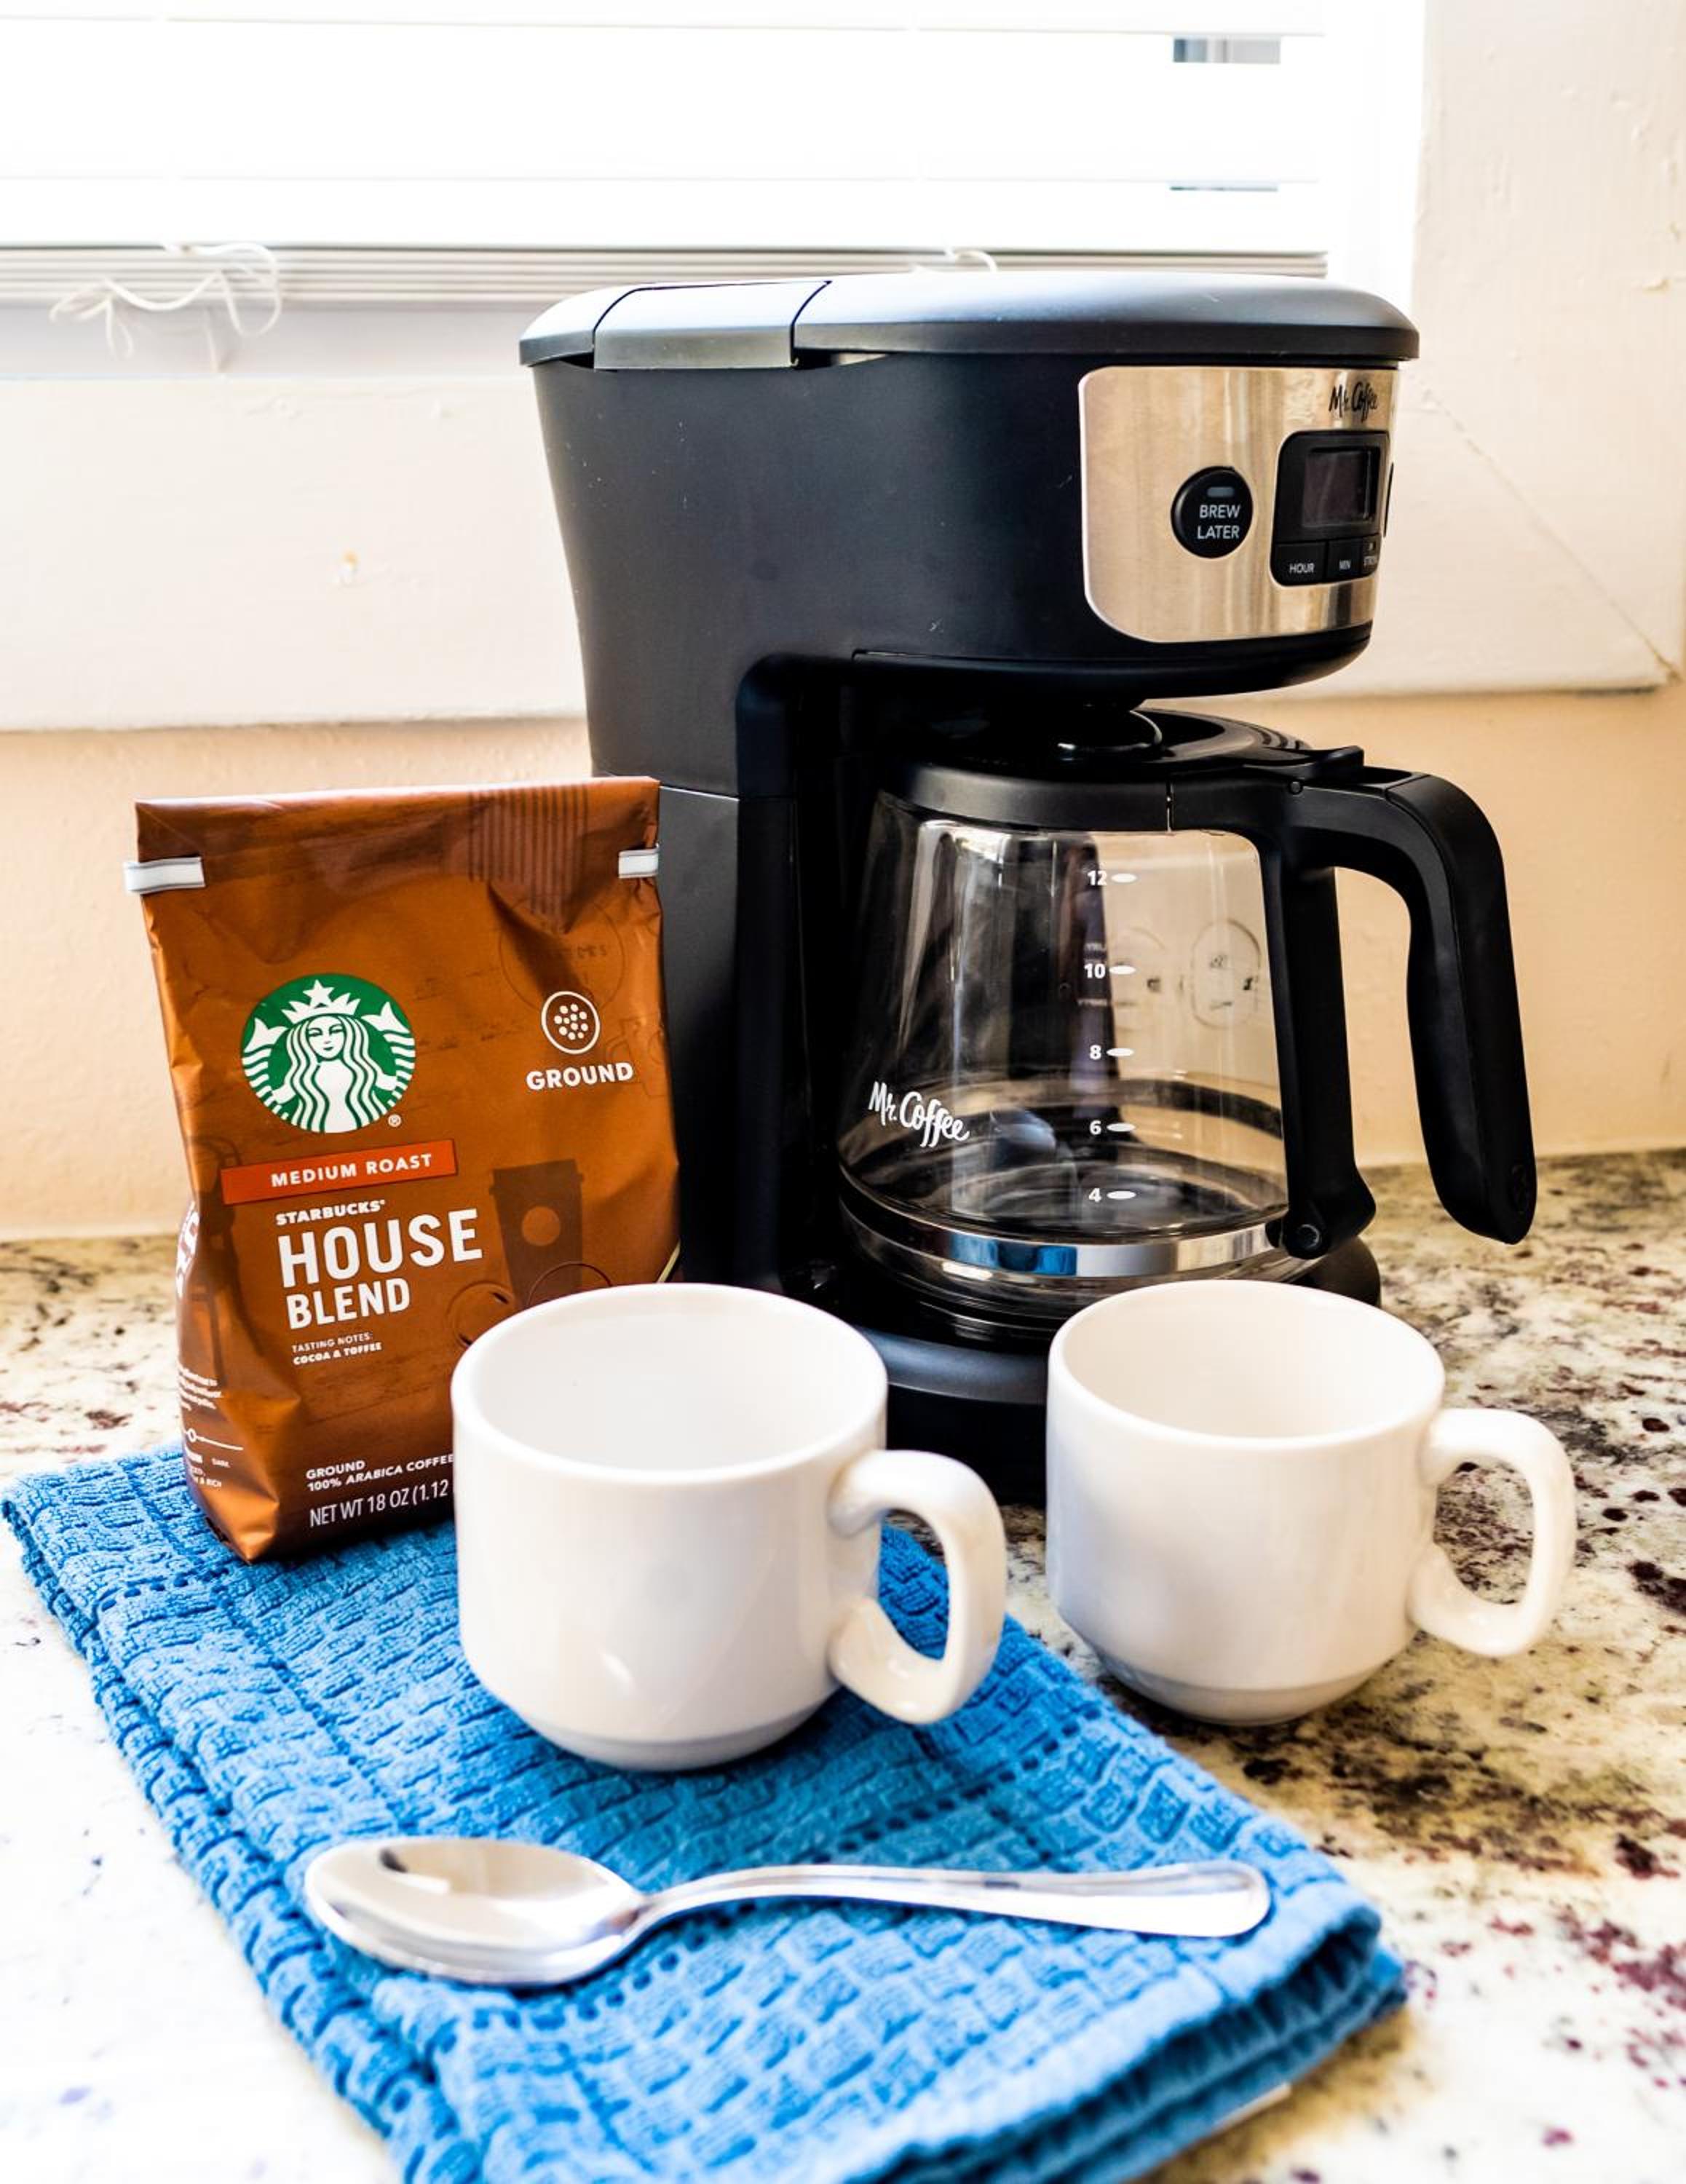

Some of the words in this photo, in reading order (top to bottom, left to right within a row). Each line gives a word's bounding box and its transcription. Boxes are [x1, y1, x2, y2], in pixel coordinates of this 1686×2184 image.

[1199, 504, 1240, 518] BREW
[1197, 525, 1240, 539] LATER
[1289, 563, 1315, 574] HOUR
[1088, 871, 1107, 885] 12
[1084, 963, 1106, 978] 10
[1090, 1045, 1101, 1059] 8
[526, 1062, 633, 1090] GROUND
[868, 1080, 898, 1126] Mr.
[899, 1091, 970, 1147] Coffee
[1090, 1120, 1101, 1135] 6
[271, 1163, 357, 1187] MEDIUM
[366, 1153, 432, 1175] ROAST
[1088, 1187, 1102, 1202] 4
[277, 1208, 483, 1288] HOUSE
[286, 1278, 411, 1329] BLEND
[292, 1338, 335, 1353] TASTING
[337, 1332, 373, 1347] NOTES:
[293, 1348, 331, 1365] COCOA
[333, 1349, 342, 1358] &
[344, 1342, 382, 1356] TOFFEE
[306, 1460, 365, 1480] GROUND
[307, 1477, 341, 1492] 100%
[346, 1465, 403, 1485] ARABICA
[406, 1454, 454, 1471] COFFEE
[309, 1503, 337, 1528] NET
[340, 1497, 364, 1521] WT
[367, 1493, 386, 1514] 18
[389, 1487, 410, 1508] OZ
[412, 1479, 449, 1506] (1.12
